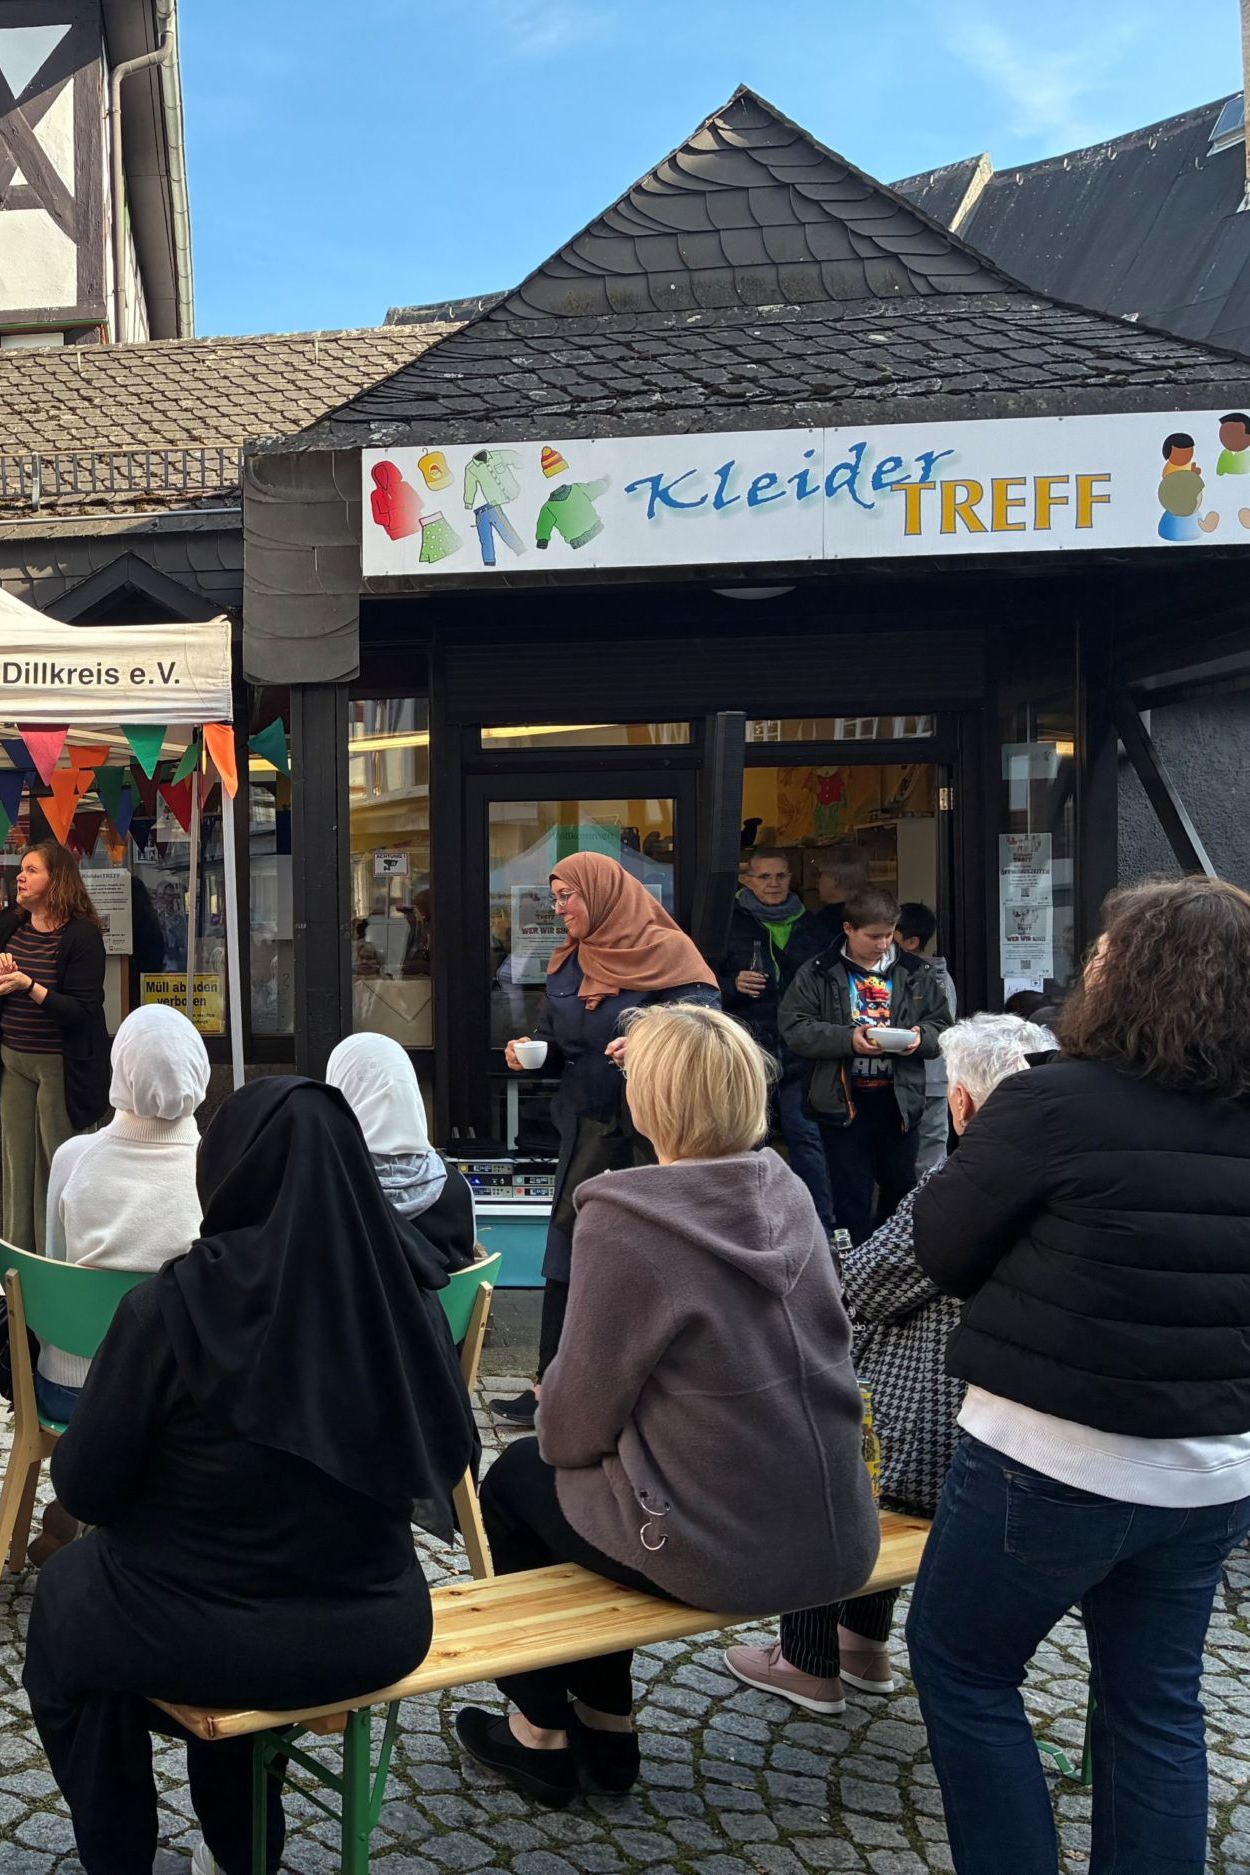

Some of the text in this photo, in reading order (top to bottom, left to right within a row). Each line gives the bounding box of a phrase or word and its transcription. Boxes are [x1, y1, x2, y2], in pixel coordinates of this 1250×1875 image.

[625, 442, 953, 520] Kleider
[892, 473, 1111, 537] TREFF
[3, 661, 120, 685] Dillkreis
[129, 661, 180, 685] e.V.
[552, 830, 614, 841] Willkommen
[521, 927, 568, 935] WER WIR SIN
[145, 981, 218, 993] Müll abaden
[157, 995, 207, 1006] verboen
